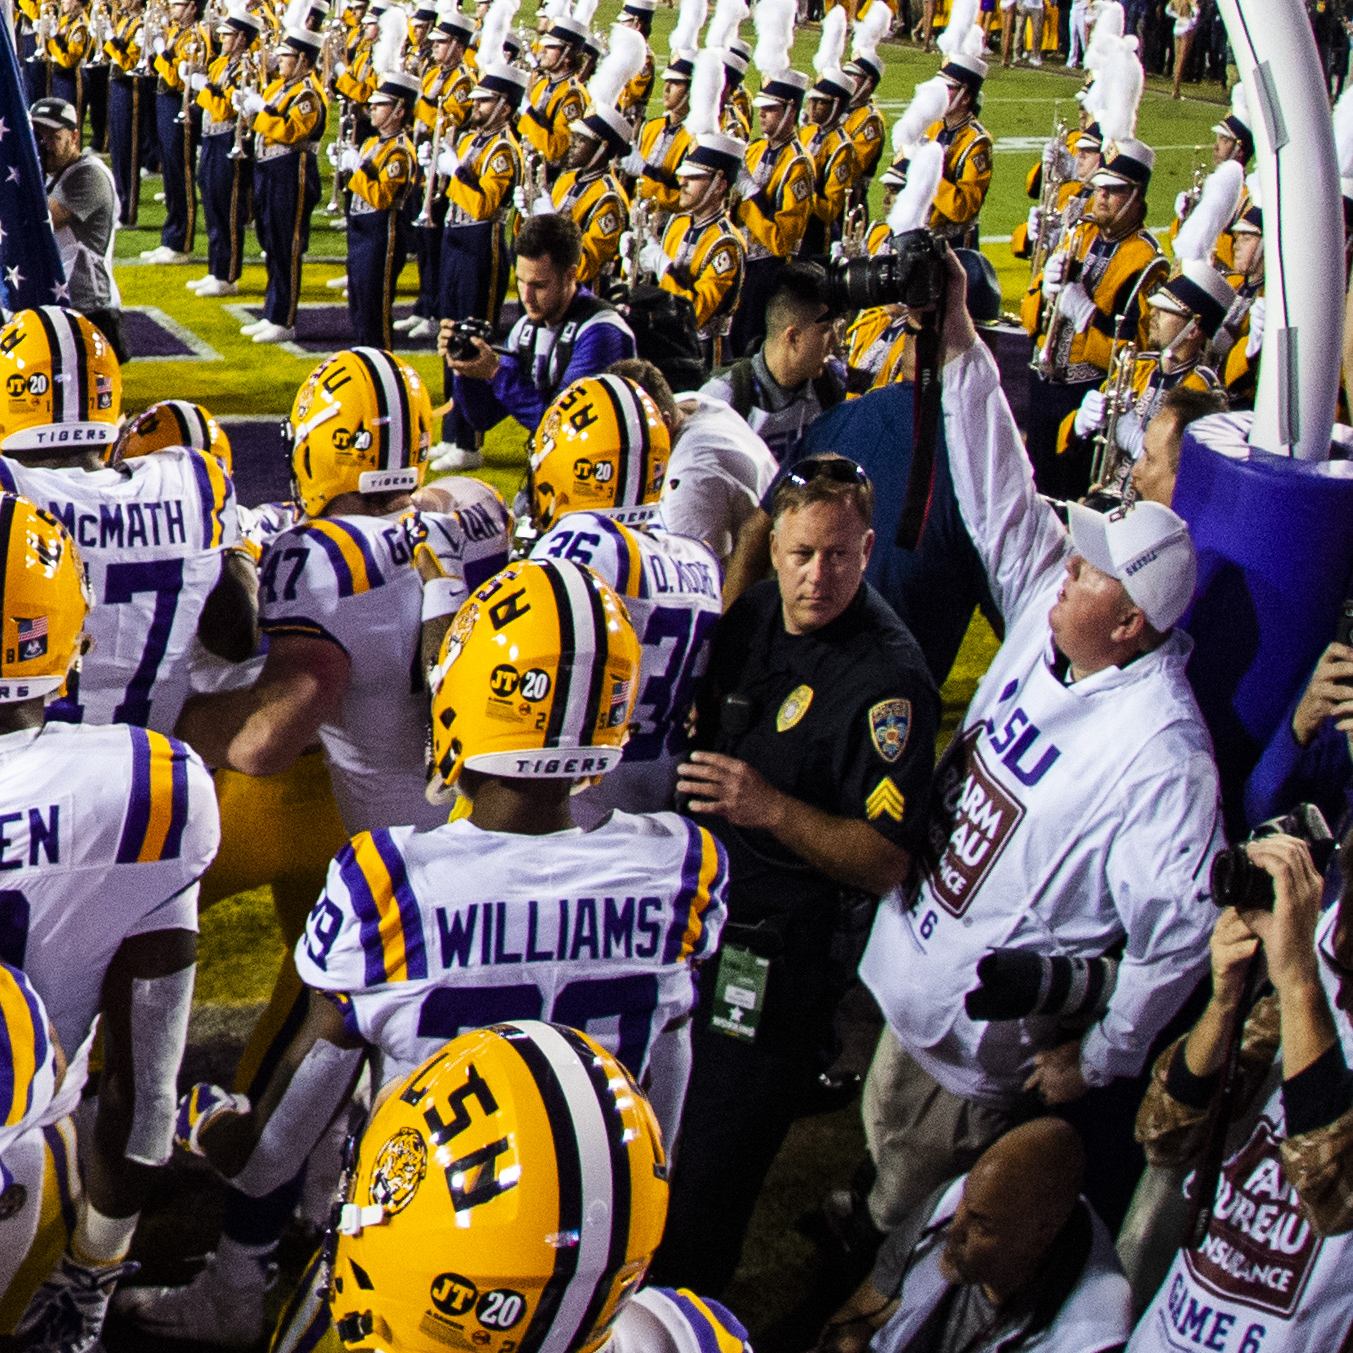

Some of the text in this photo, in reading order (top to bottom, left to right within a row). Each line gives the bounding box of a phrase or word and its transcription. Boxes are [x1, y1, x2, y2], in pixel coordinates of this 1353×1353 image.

[8, 375, 47, 394] JT 20
[558, 387, 598, 430] SU
[37, 430, 106, 444] TIGERS
[334, 431, 371, 449] JT 20
[370, 475, 415, 487] TIGERS
[575, 461, 612, 481] JT 20
[49, 499, 187, 550] McMATH
[613, 508, 656, 524] GERS
[493, 669, 548, 699] JT 20
[516, 758, 609, 774] TIGERS
[958, 775, 1005, 840] ARM
[437, 897, 664, 969] WILLIAMS
[919, 911, 940, 942] 6
[1212, 1172, 1311, 1255] UREAU
[432, 1279, 474, 1311] JT
[479, 1291, 521, 1326] 20
